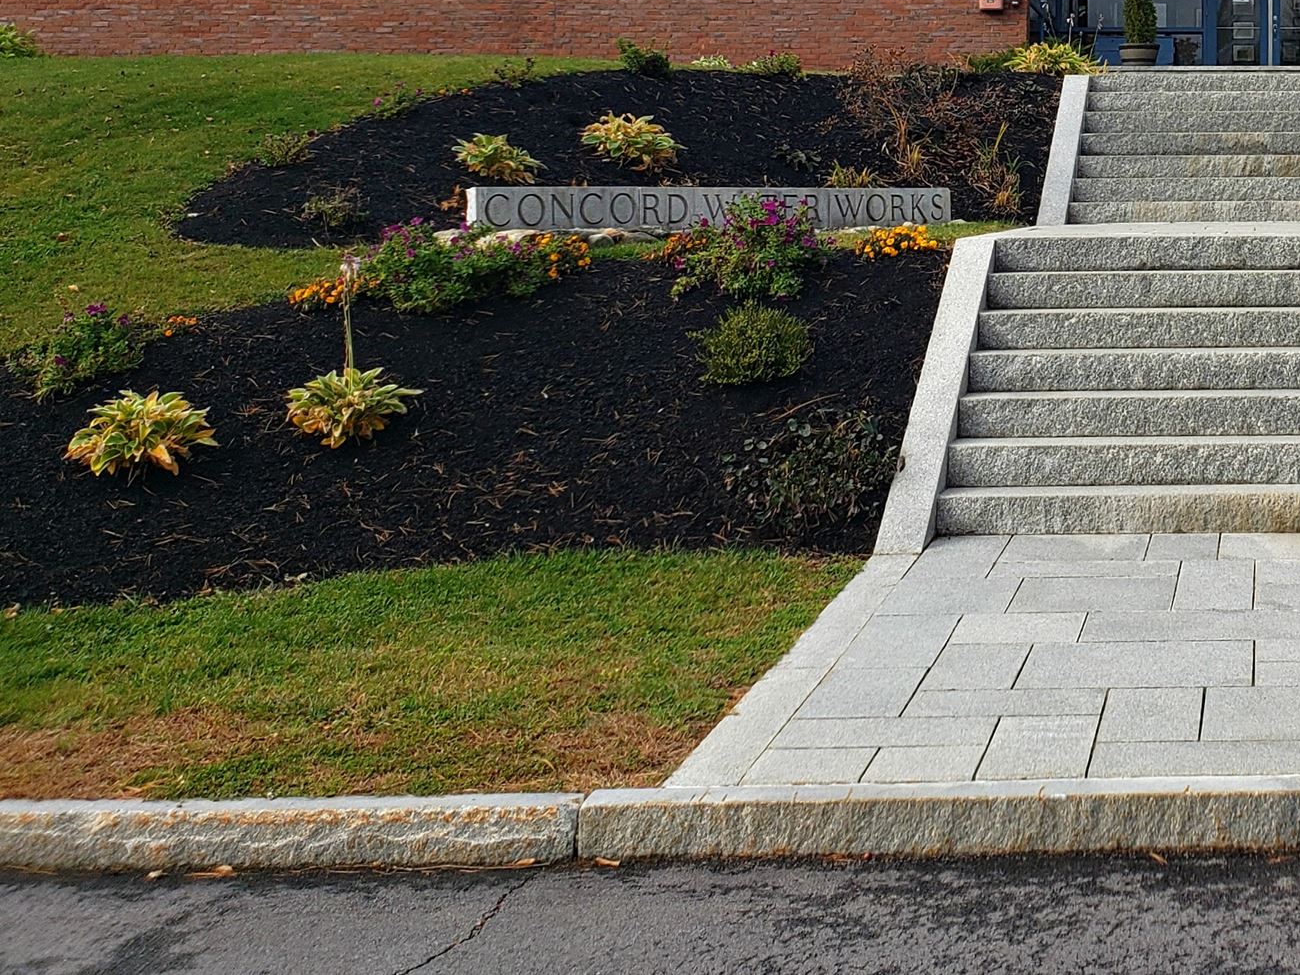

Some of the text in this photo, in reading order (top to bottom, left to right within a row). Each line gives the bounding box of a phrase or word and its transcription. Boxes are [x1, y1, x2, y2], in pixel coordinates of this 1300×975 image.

[484, 192, 944, 227] CONCORD WER WORKS
